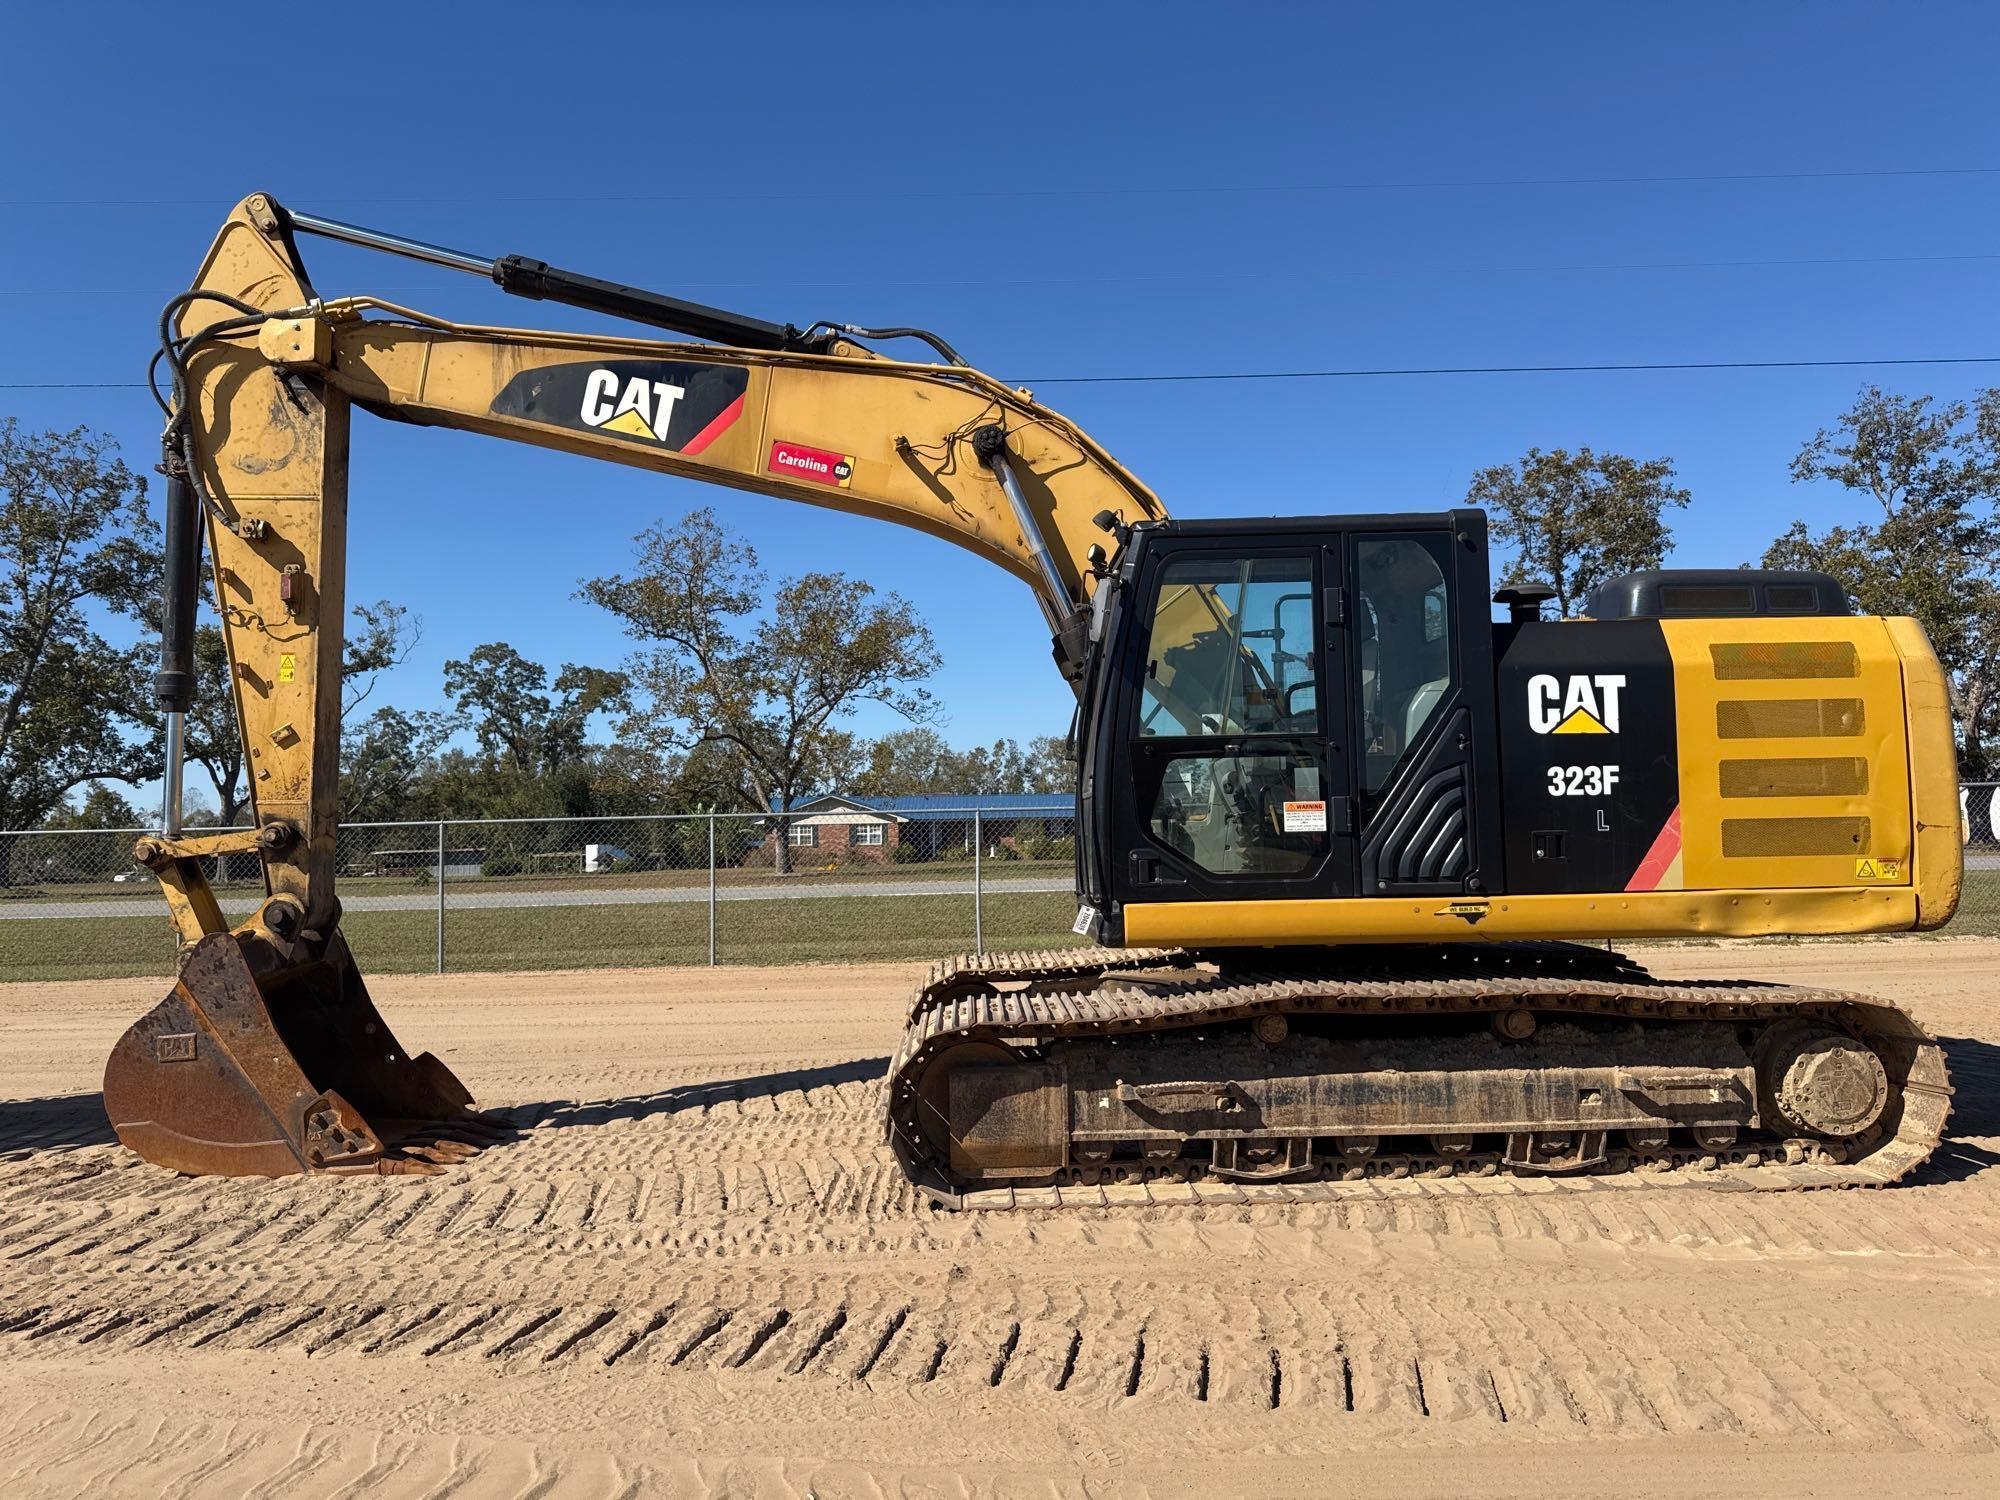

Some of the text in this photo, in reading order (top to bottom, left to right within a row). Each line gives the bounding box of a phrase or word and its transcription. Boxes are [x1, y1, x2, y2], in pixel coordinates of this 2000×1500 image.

[580, 368, 685, 442] CAT
[778, 451, 828, 473] Carolina
[835, 466, 849, 476] CAT
[1527, 674, 1626, 734] CAT
[1547, 765, 1620, 796] 323F
[1597, 810, 1610, 831] L
